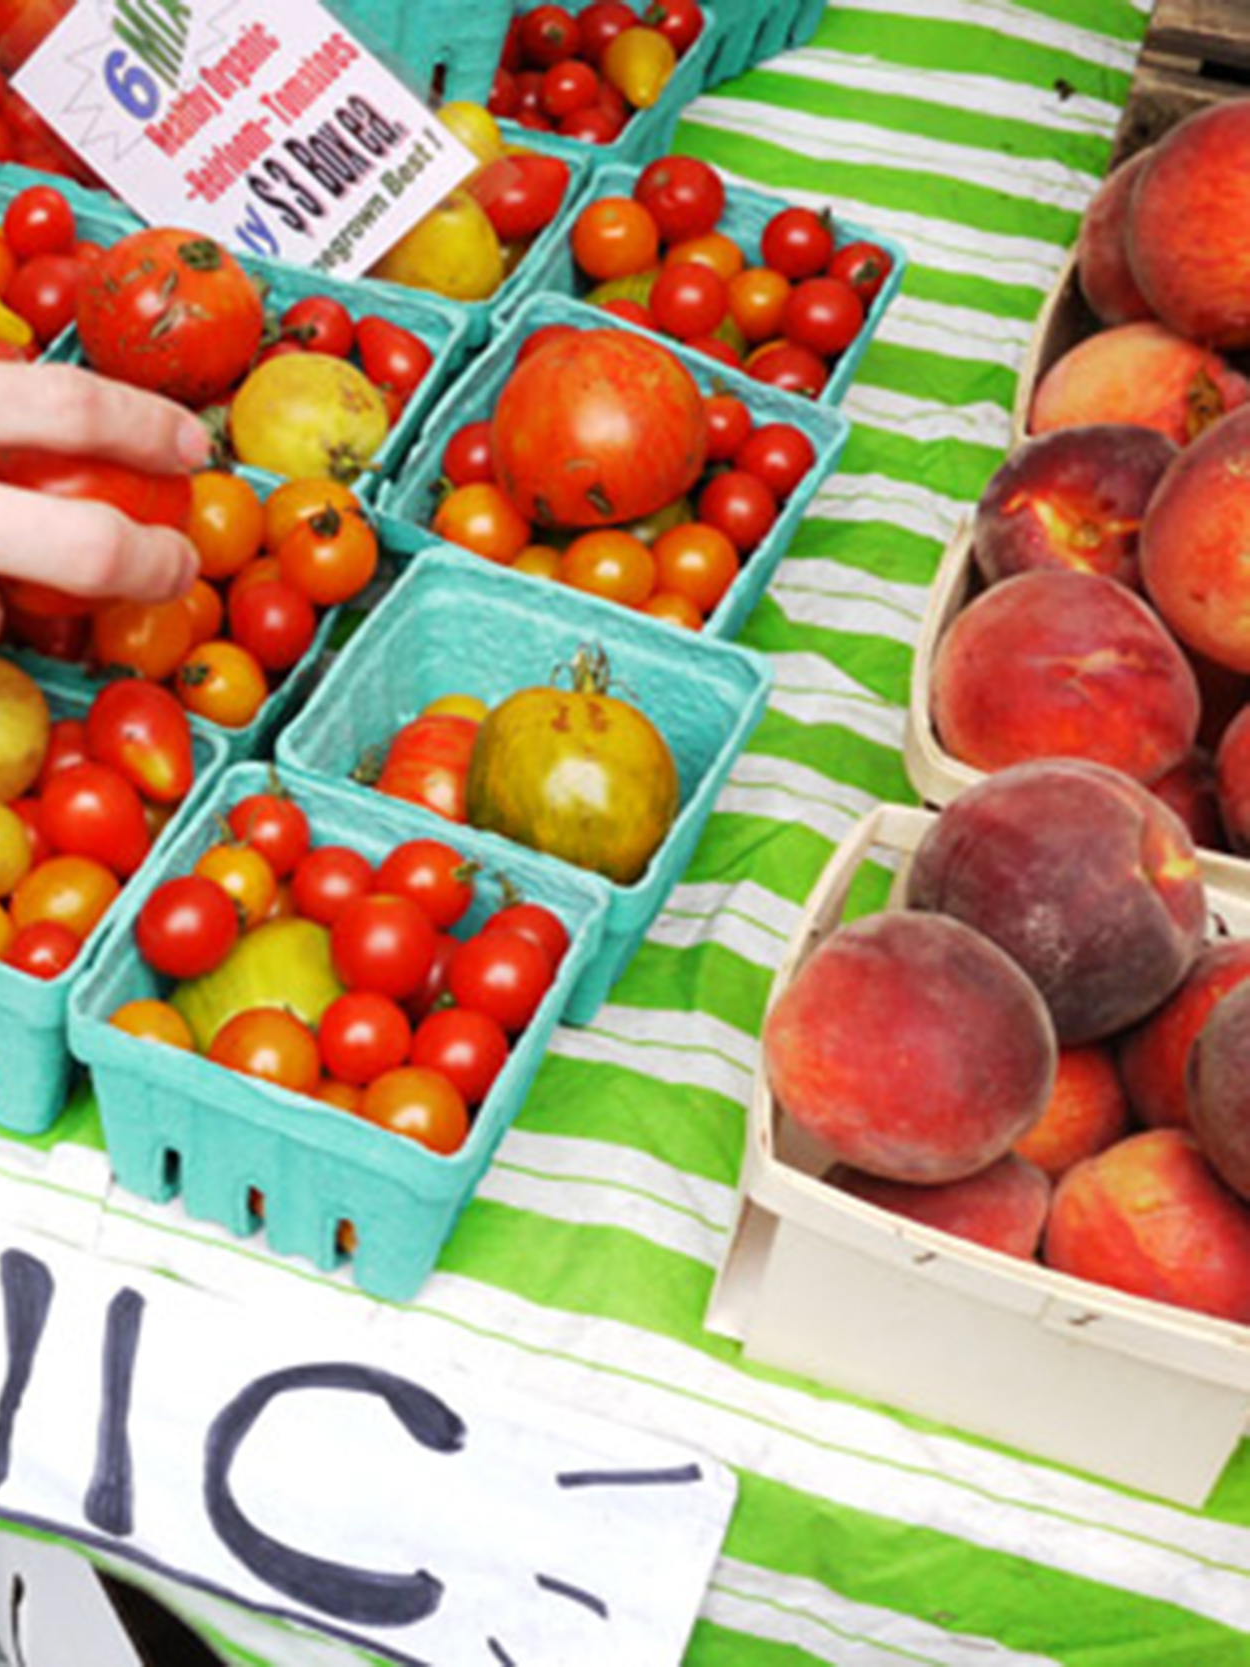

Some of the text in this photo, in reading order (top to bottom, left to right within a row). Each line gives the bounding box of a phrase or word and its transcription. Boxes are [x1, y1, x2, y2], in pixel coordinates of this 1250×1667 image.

[104, 49, 160, 121] 6
[143, 22, 281, 159] Healthy Organic
[259, 31, 360, 126] Tomatoes
[380, 141, 434, 199] Best
